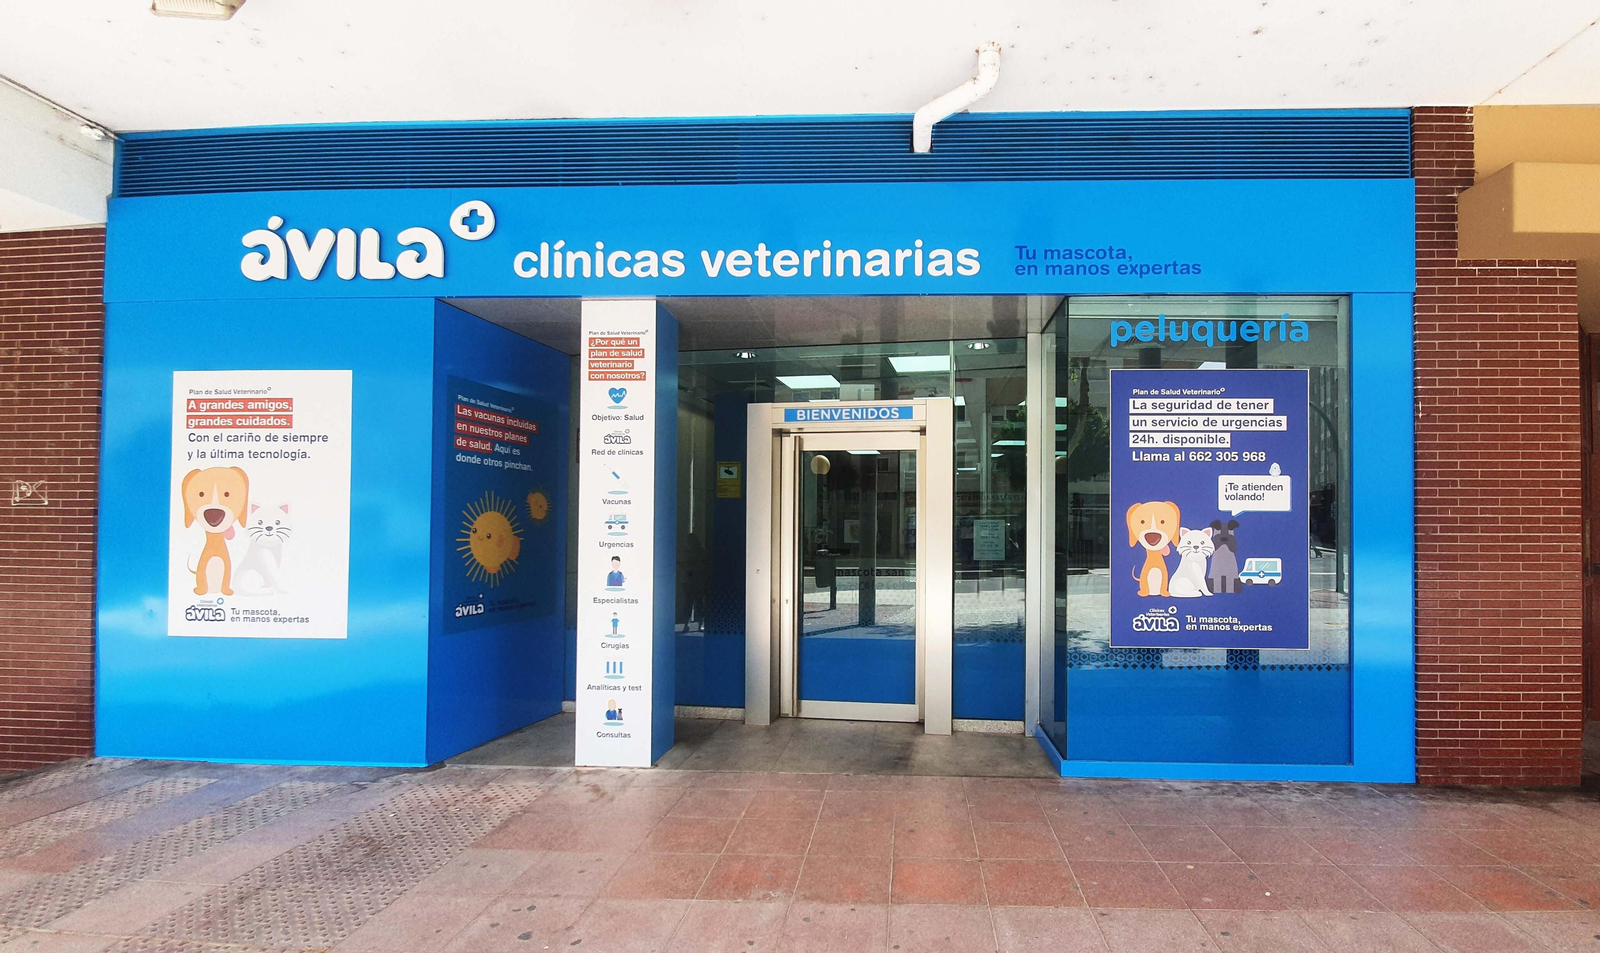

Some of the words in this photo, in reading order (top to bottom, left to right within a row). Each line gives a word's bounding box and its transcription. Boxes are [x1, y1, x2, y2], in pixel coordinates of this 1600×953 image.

[513, 239, 686, 279] clínicas
[700, 238, 981, 278] veterinarias
[1015, 245, 1037, 260] Tu
[1043, 245, 1133, 262] mascota,
[1015, 263, 1038, 276] en
[1045, 263, 1110, 276] manos
[1117, 260, 1202, 278] expertas
[1110, 313, 1309, 347] peluquería
[590, 339, 609, 347] ¿Por
[610, 338, 626, 347] qué
[590, 350, 607, 358] plan
[188, 400, 197, 410] A
[199, 400, 244, 412] grandes
[247, 400, 293, 412] amigos,
[1132, 400, 1147, 410] La
[1151, 400, 1213, 412] seguridad
[1216, 400, 1232, 410] de
[1236, 400, 1269, 410] tener
[457, 404, 472, 417] Las
[474, 410, 505, 424] vacunas
[506, 416, 536, 431] incluidas
[591, 414, 622, 422] Objetivo:
[796, 407, 900, 420] BIENVENIDOS
[188, 417, 233, 429] grandes
[235, 416, 290, 426] cuidados.
[1132, 419, 1147, 427] un
[1151, 417, 1199, 427] servicio
[1202, 417, 1218, 427] de
[1222, 417, 1283, 429] urgencias
[188, 433, 209, 443] Con
[213, 433, 223, 443] el
[226, 433, 261, 443] cariño
[265, 433, 279, 443] de
[282, 433, 329, 444] siempre
[456, 422, 468, 431] en
[469, 425, 503, 438] nuestros
[504, 431, 527, 443] planes
[1132, 434, 1158, 444] 24h.
[1162, 434, 1230, 446] disponible.
[456, 437, 467, 447] de
[469, 440, 493, 451] salud.
[494, 443, 511, 455] Aquí
[512, 448, 521, 456] es
[187, 451, 193, 461] y
[196, 449, 206, 459] la
[210, 448, 244, 459] última
[248, 449, 311, 461] tecnología.
[1132, 451, 1170, 461] Llama
[1174, 451, 1185, 461] al
[1189, 451, 1212, 461] 662
[1216, 451, 1239, 461] 305
[1242, 451, 1266, 461] 968
[455, 452, 481, 464] donde
[483, 458, 503, 467] otros
[504, 460, 533, 471] pinchan.
[1225, 482, 1239, 492] ¡Te
[1241, 483, 1283, 491] atienden
[1224, 492, 1265, 501] volando!
[598, 541, 634, 549] Urgencias
[834, 568, 883, 577] mascota
[593, 597, 639, 605] Especialistas
[242, 608, 280, 616] mascota,
[273, 616, 310, 624] expertas
[1185, 615, 1197, 623] Tu
[1199, 615, 1241, 624] mascota,
[1232, 624, 1273, 632] expertas
